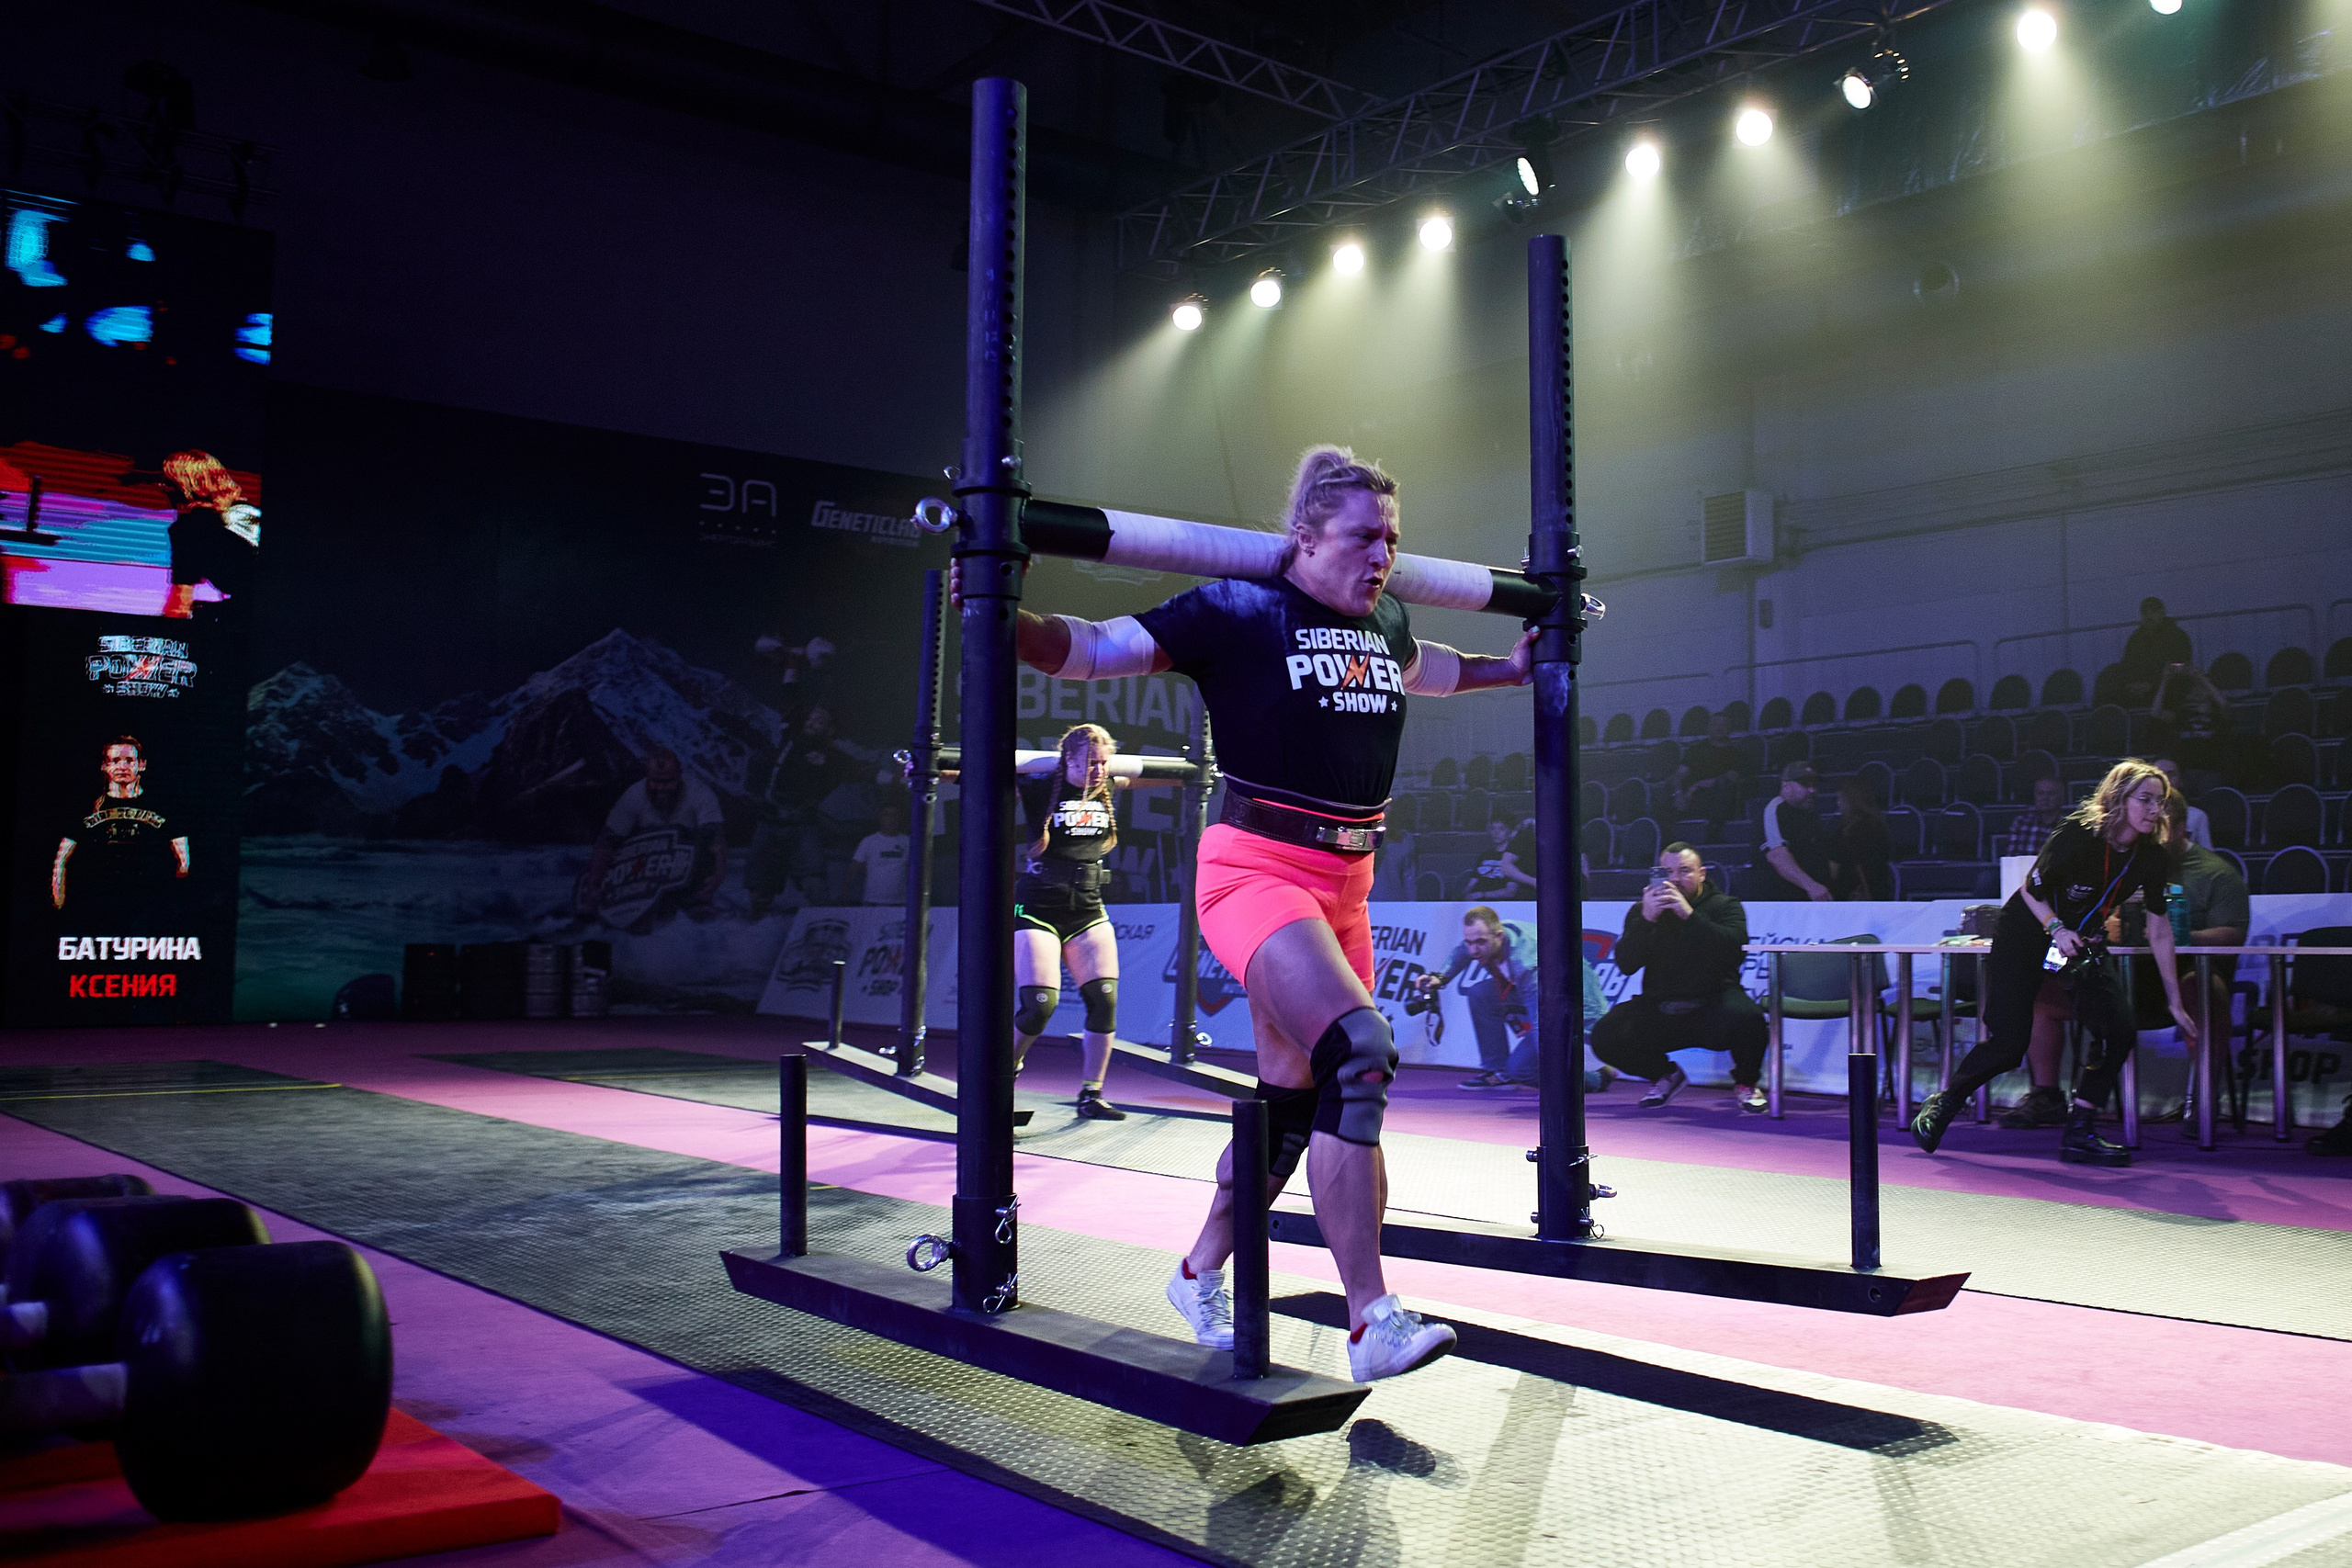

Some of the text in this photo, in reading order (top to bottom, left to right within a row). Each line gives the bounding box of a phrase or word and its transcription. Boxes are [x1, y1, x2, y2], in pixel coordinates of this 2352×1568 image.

[1295, 627, 1390, 656] SIBERIAN
[86, 653, 198, 687] POWER
[1286, 653, 1406, 696] POWER
[1332, 692, 1387, 714] SHOW
[1053, 811, 1110, 829] POWER
[58, 936, 201, 961] БАТУРИНА
[69, 974, 177, 998] КСЕНИЯ
